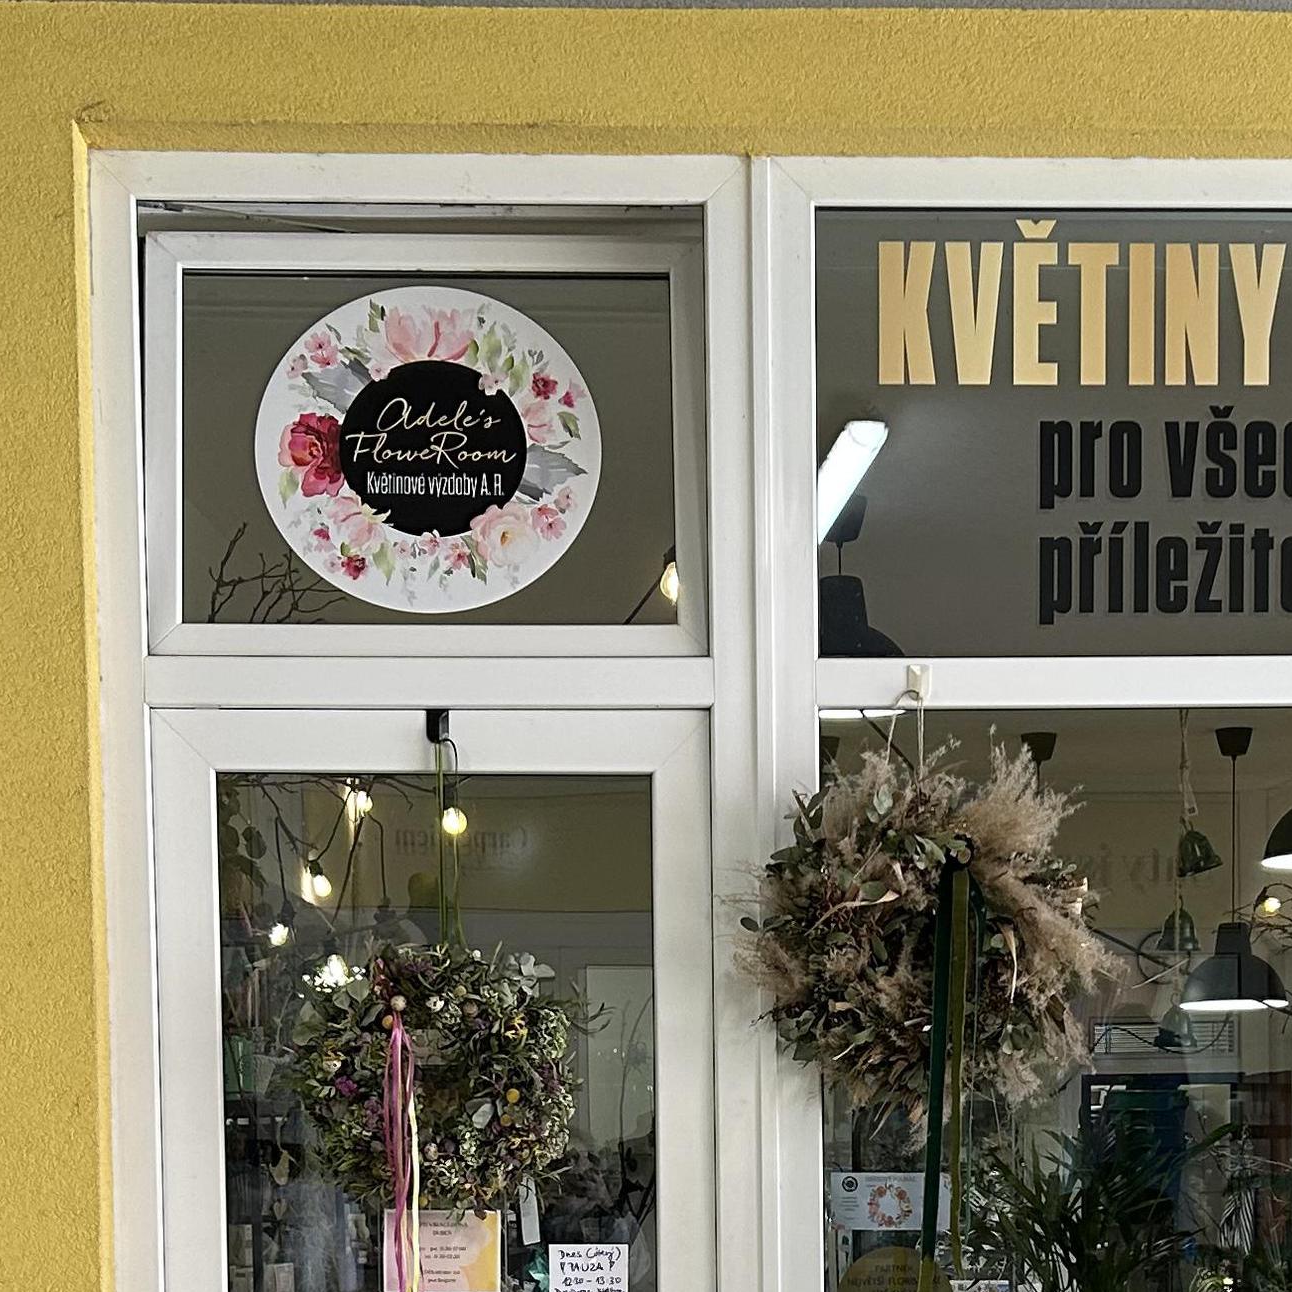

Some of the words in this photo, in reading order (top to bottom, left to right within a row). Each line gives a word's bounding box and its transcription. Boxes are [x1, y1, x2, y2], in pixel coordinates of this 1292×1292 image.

[878, 219, 1287, 385] KVĚTINY
[345, 432, 517, 467] FloweRoom
[1039, 420, 1143, 509] pro
[366, 469, 426, 497] Květinové
[428, 471, 479, 498] výzdoby
